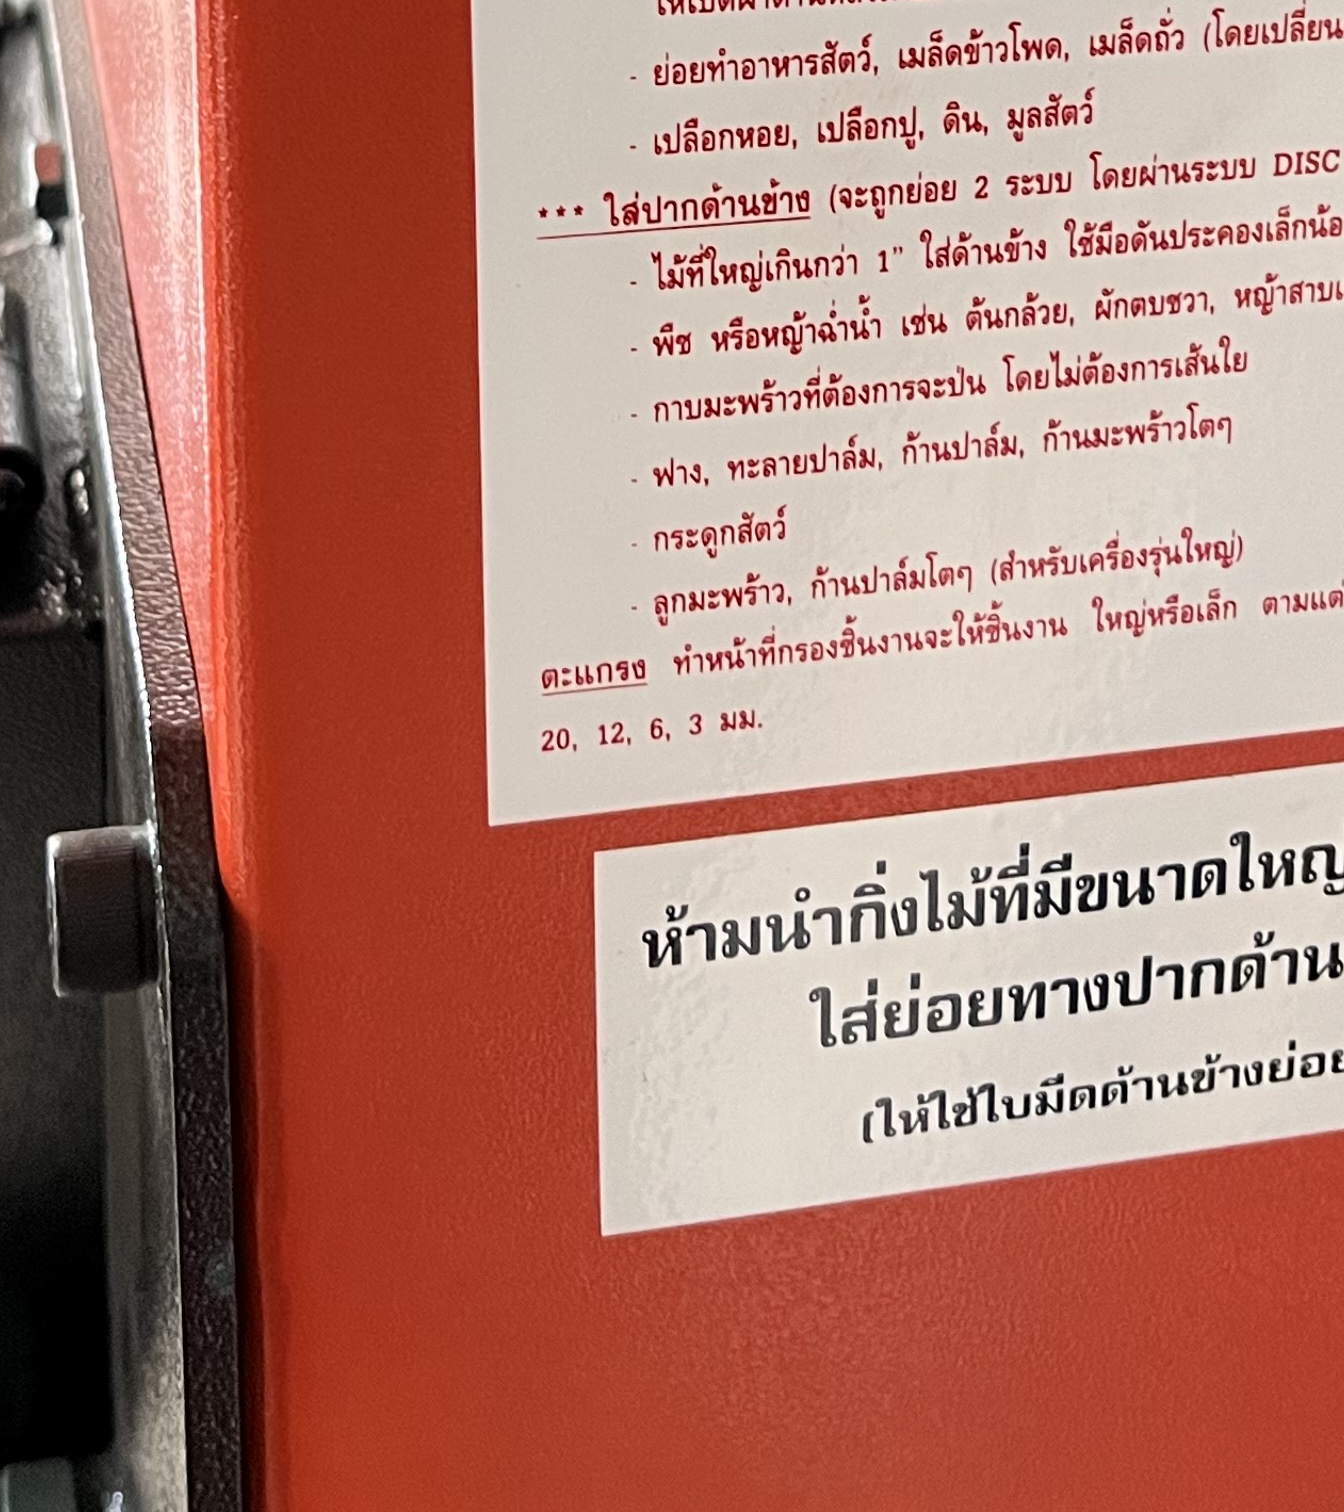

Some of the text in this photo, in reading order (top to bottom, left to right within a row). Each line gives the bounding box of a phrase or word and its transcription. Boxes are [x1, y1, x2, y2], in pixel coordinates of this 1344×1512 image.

[897, 19, 1070, 71] เมล็ดข้าวโพด,
[1087, 7, 1185, 57] เมล็ดถั่ว
[652, 85, 1095, 156] เปลือกหอย, เปลือกปู, ดิน, มูลสัตว์
[601, 176, 813, 229] ใส่ปากด้านข้าง
[828, 173, 957, 220] (จะถูกย่อย
[973, 174, 989, 200] 2
[1004, 170, 1072, 197] ระบบ
[1087, 149, 1257, 191] โดยผ่านระบบ
[1272, 147, 1341, 177] DISC
[649, 243, 858, 294] ไม้ที่ใหญ่เกินกว่า
[918, 226, 1047, 270] ใส่ด้านข้าง
[650, 320, 692, 357] พืช
[709, 292, 882, 356] หรือหญ้าฉ่ำน้ำ
[900, 306, 948, 338] เช่น
[964, 290, 1075, 332] ต้นกล้วย,
[1093, 286, 1216, 321] ผักตบชวา,
[652, 333, 1248, 421] กาบมะพร้าวที่ต้องการจะป่น โดยไม่ต้องการเส้นใย
[651, 400, 1233, 487] ฟาง, ทะลายปาล์ม, ก้านปาล์ม, ก้านมะพร้าวโตๆ
[652, 503, 787, 560] กระดูกสัตว์
[653, 524, 1244, 628] ลูกมะพร้าว, ก้านปาล์มโตๆ (สำหรับเครื่องรุ่นใหญ่)
[540, 658, 648, 691] ตะแกรง
[1090, 588, 1238, 639] ใหญ่หรือเล็ก
[540, 709, 762, 753] 20, 12, 6, 3 มม.
